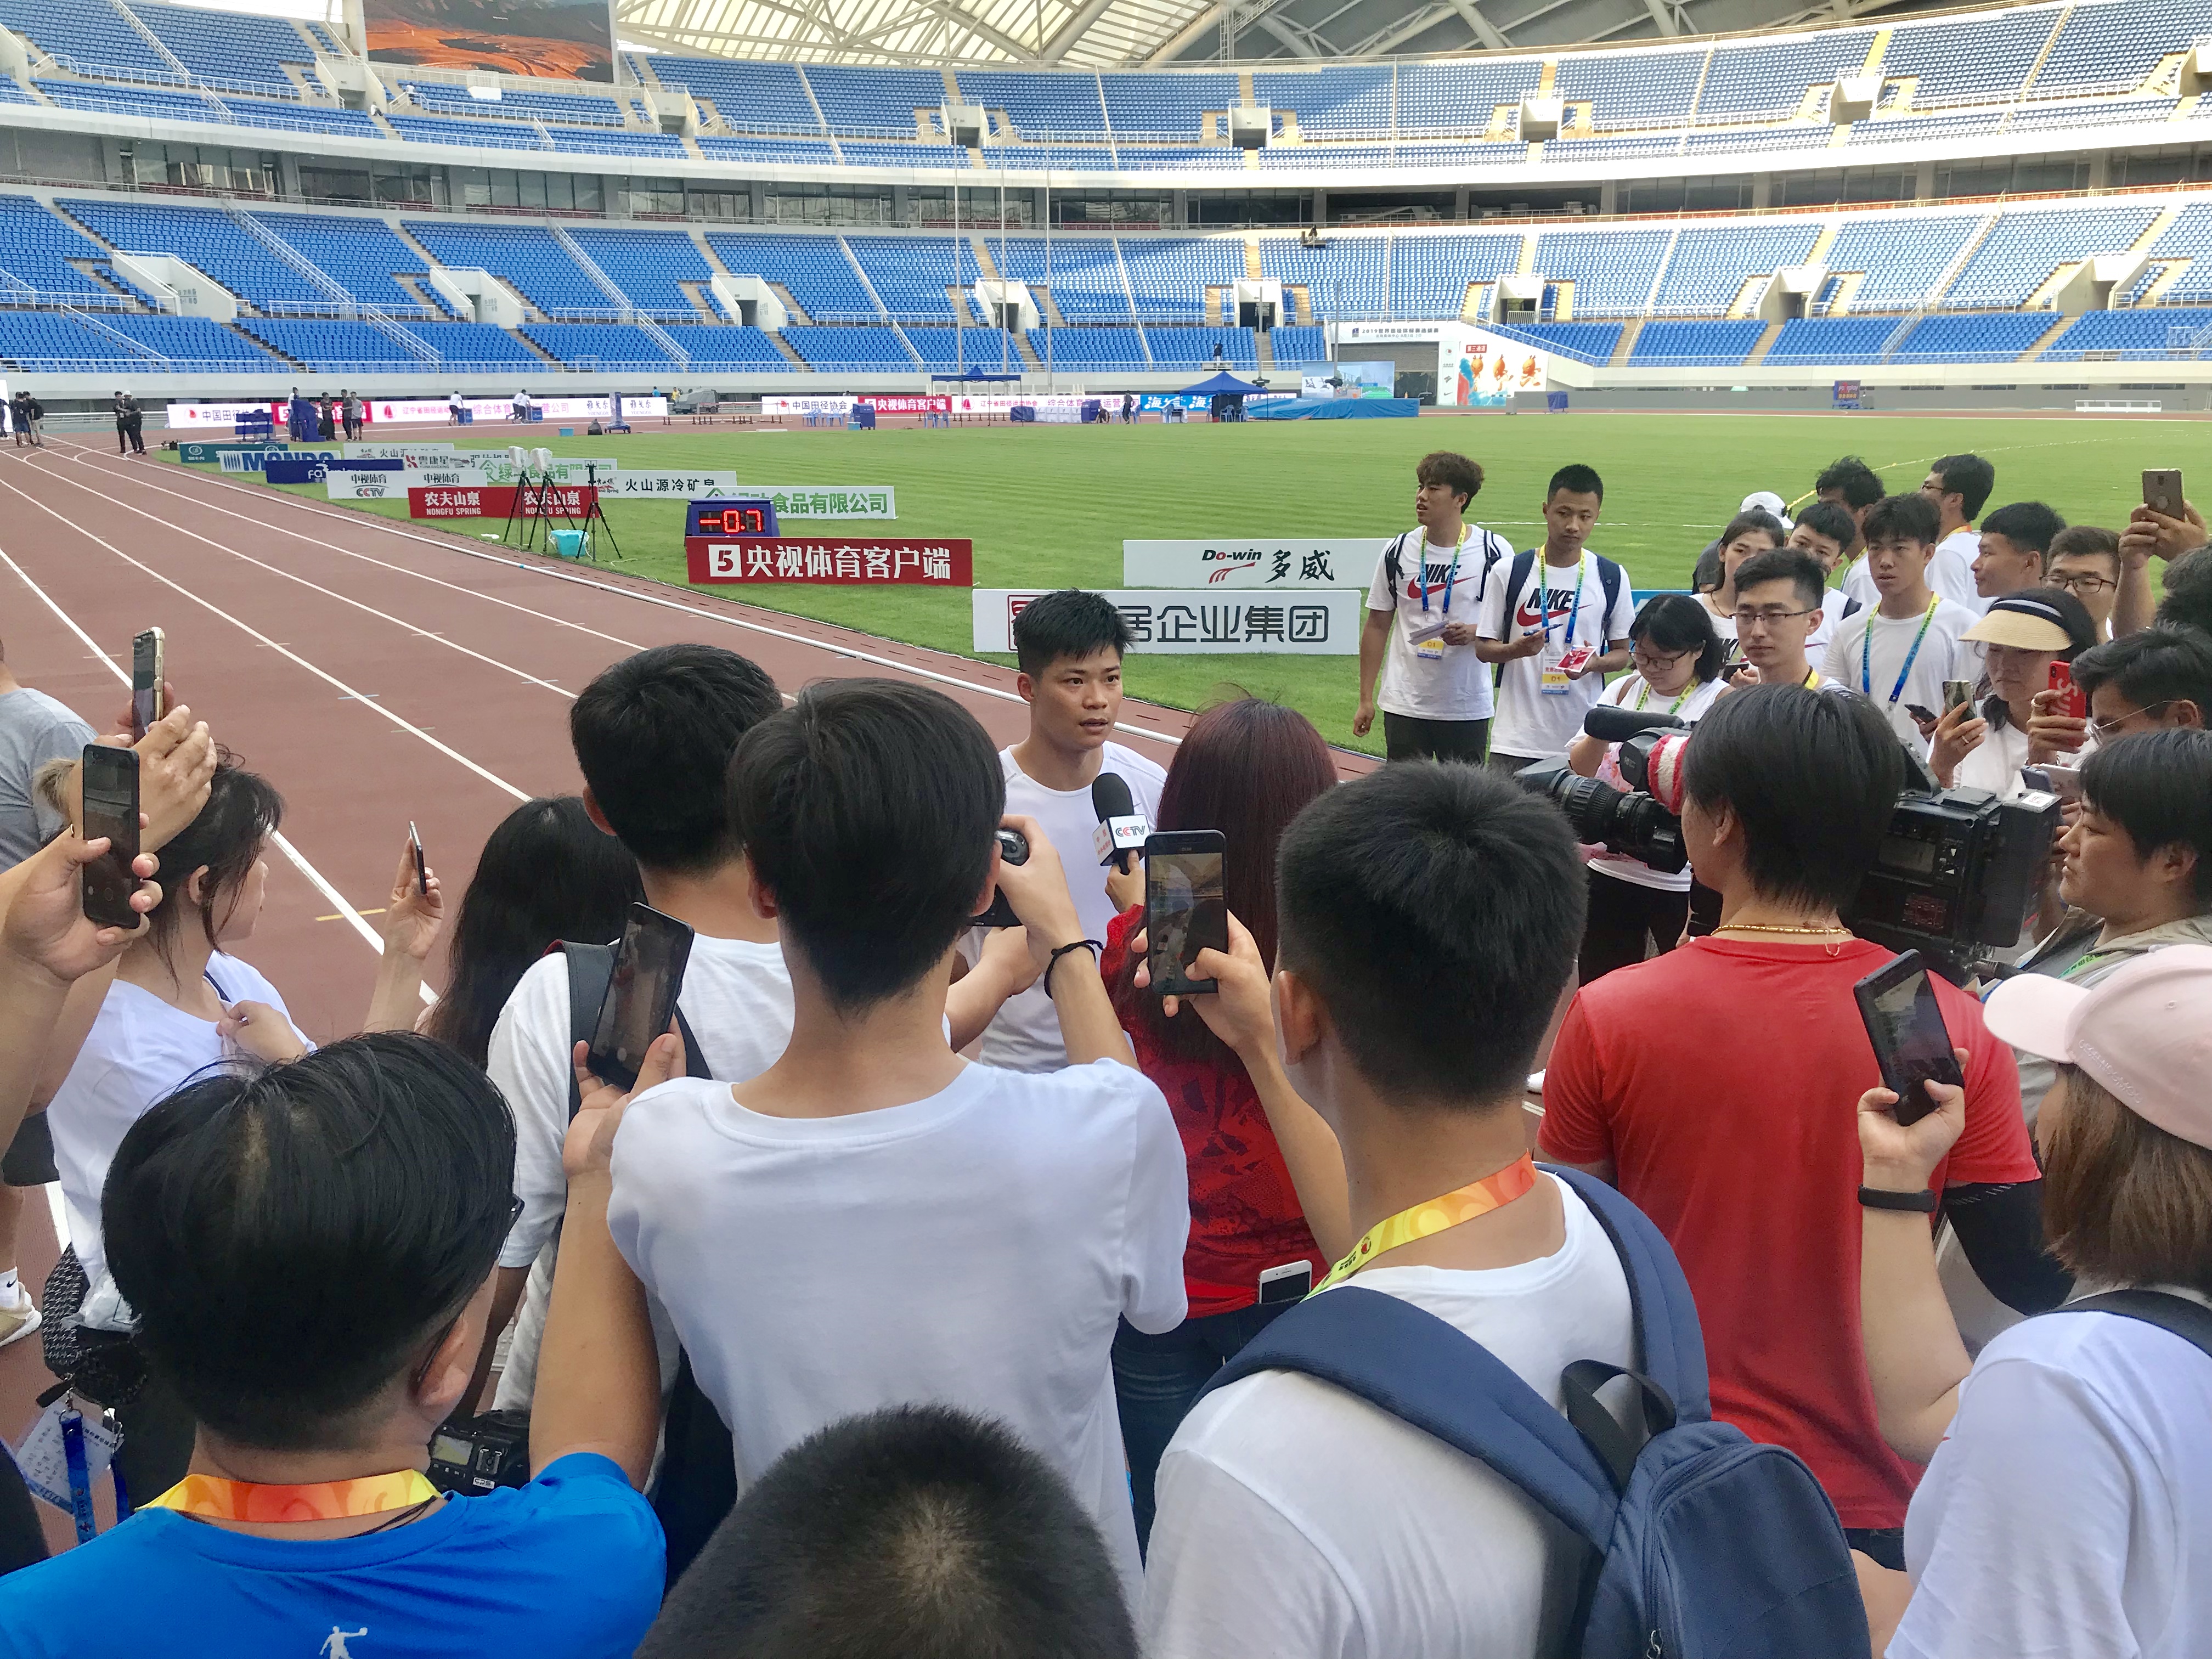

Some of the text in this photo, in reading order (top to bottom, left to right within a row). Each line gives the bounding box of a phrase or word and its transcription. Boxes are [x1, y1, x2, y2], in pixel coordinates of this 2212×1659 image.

[587, 400, 608, 409] 雅戈尔
[630, 399, 651, 409] 雅戈尔
[792, 400, 847, 410] 中国田径协会
[878, 398, 946, 410] 央视体育客户端
[202, 410, 249, 421] 中国田径
[403, 406, 450, 415] 辽宁省田径运动
[351, 473, 387, 484] 中视体育
[424, 473, 460, 483] 中视体育
[356, 488, 385, 497] CCTV
[425, 491, 481, 506] 农夫山泉
[524, 490, 580, 506] 农夫山泉
[732, 492, 888, 514] 食品有限公司
[426, 507, 481, 516] NONGFU SPRING
[699, 509, 763, 534] -0.7
[1202, 549, 1262, 561] Do-win
[747, 544, 951, 580] 央视体育客户端
[1264, 549, 1335, 584] 多威
[1526, 588, 1576, 611] NIKE
[1115, 825, 1146, 837] CCTV
